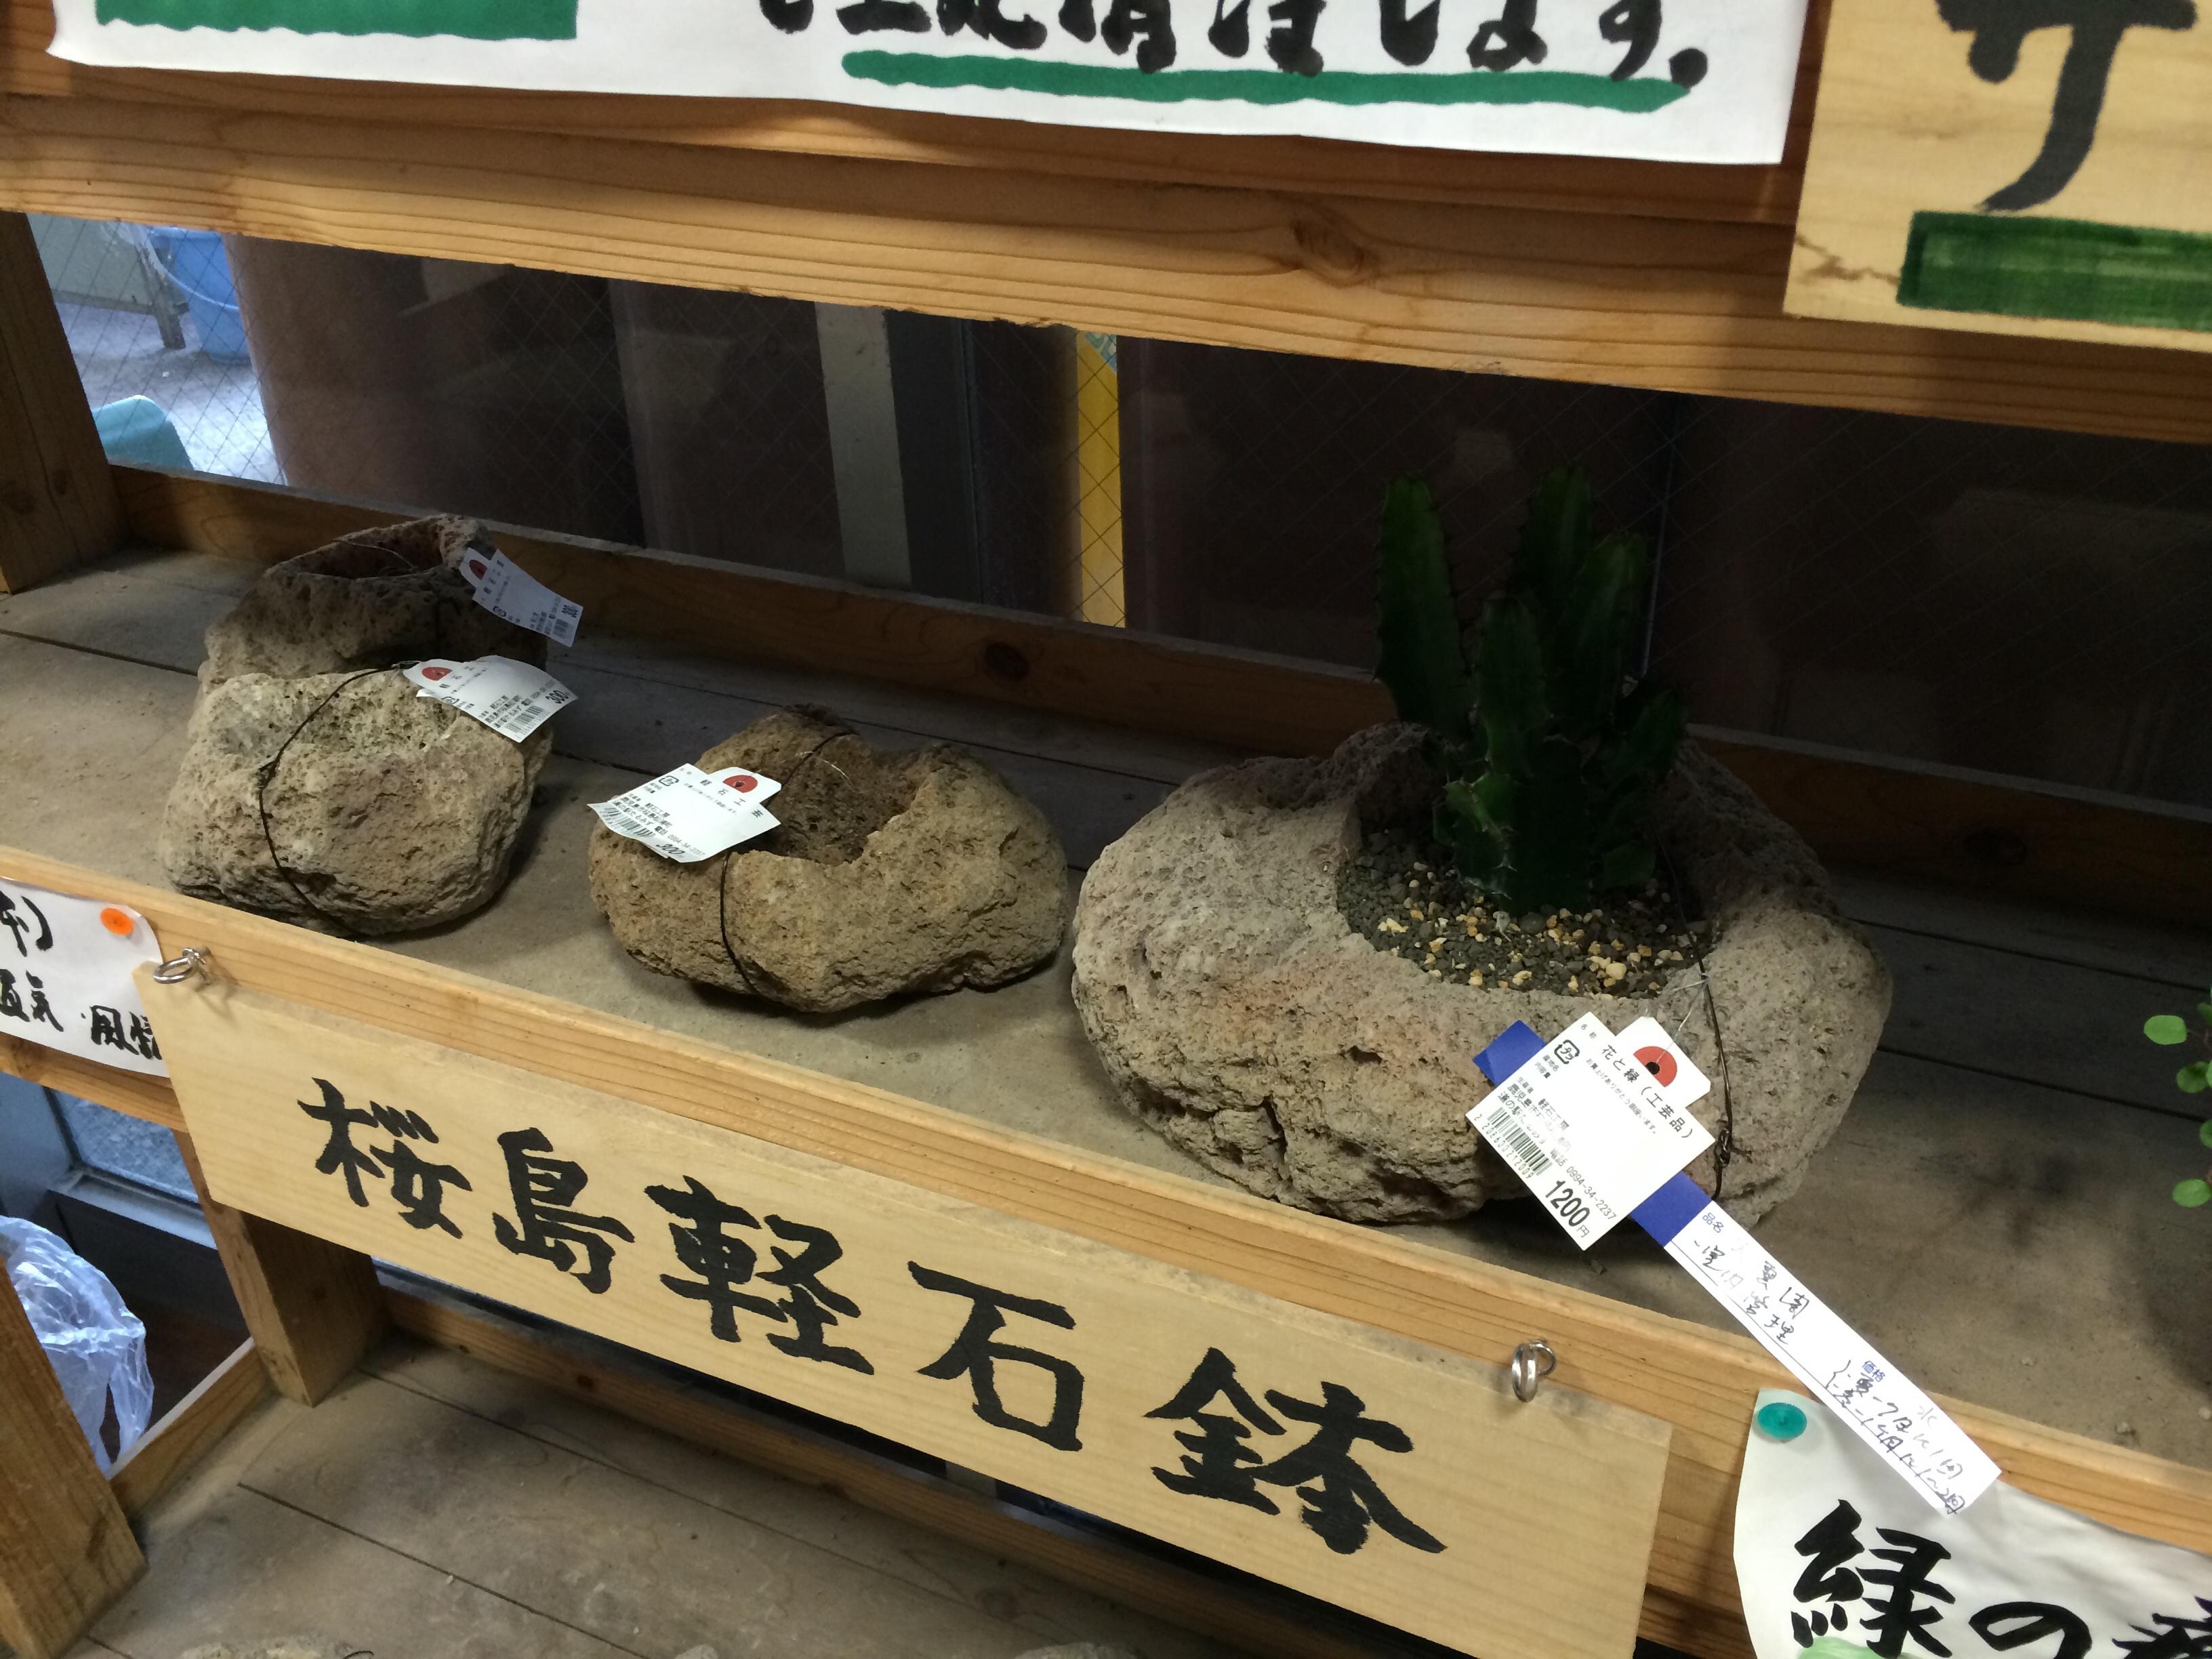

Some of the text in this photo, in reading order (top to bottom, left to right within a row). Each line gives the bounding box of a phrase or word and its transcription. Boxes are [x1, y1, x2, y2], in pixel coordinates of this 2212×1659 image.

[1566, 1166, 1616, 1219] 0994-34-2237
[1702, 1212, 1723, 1233] 品名
[297, 1078, 1446, 1553] 桜島軽石鉢
[1862, 1360, 1885, 1382] 価格
[1790, 1499, 2212, 1659] 緑の
